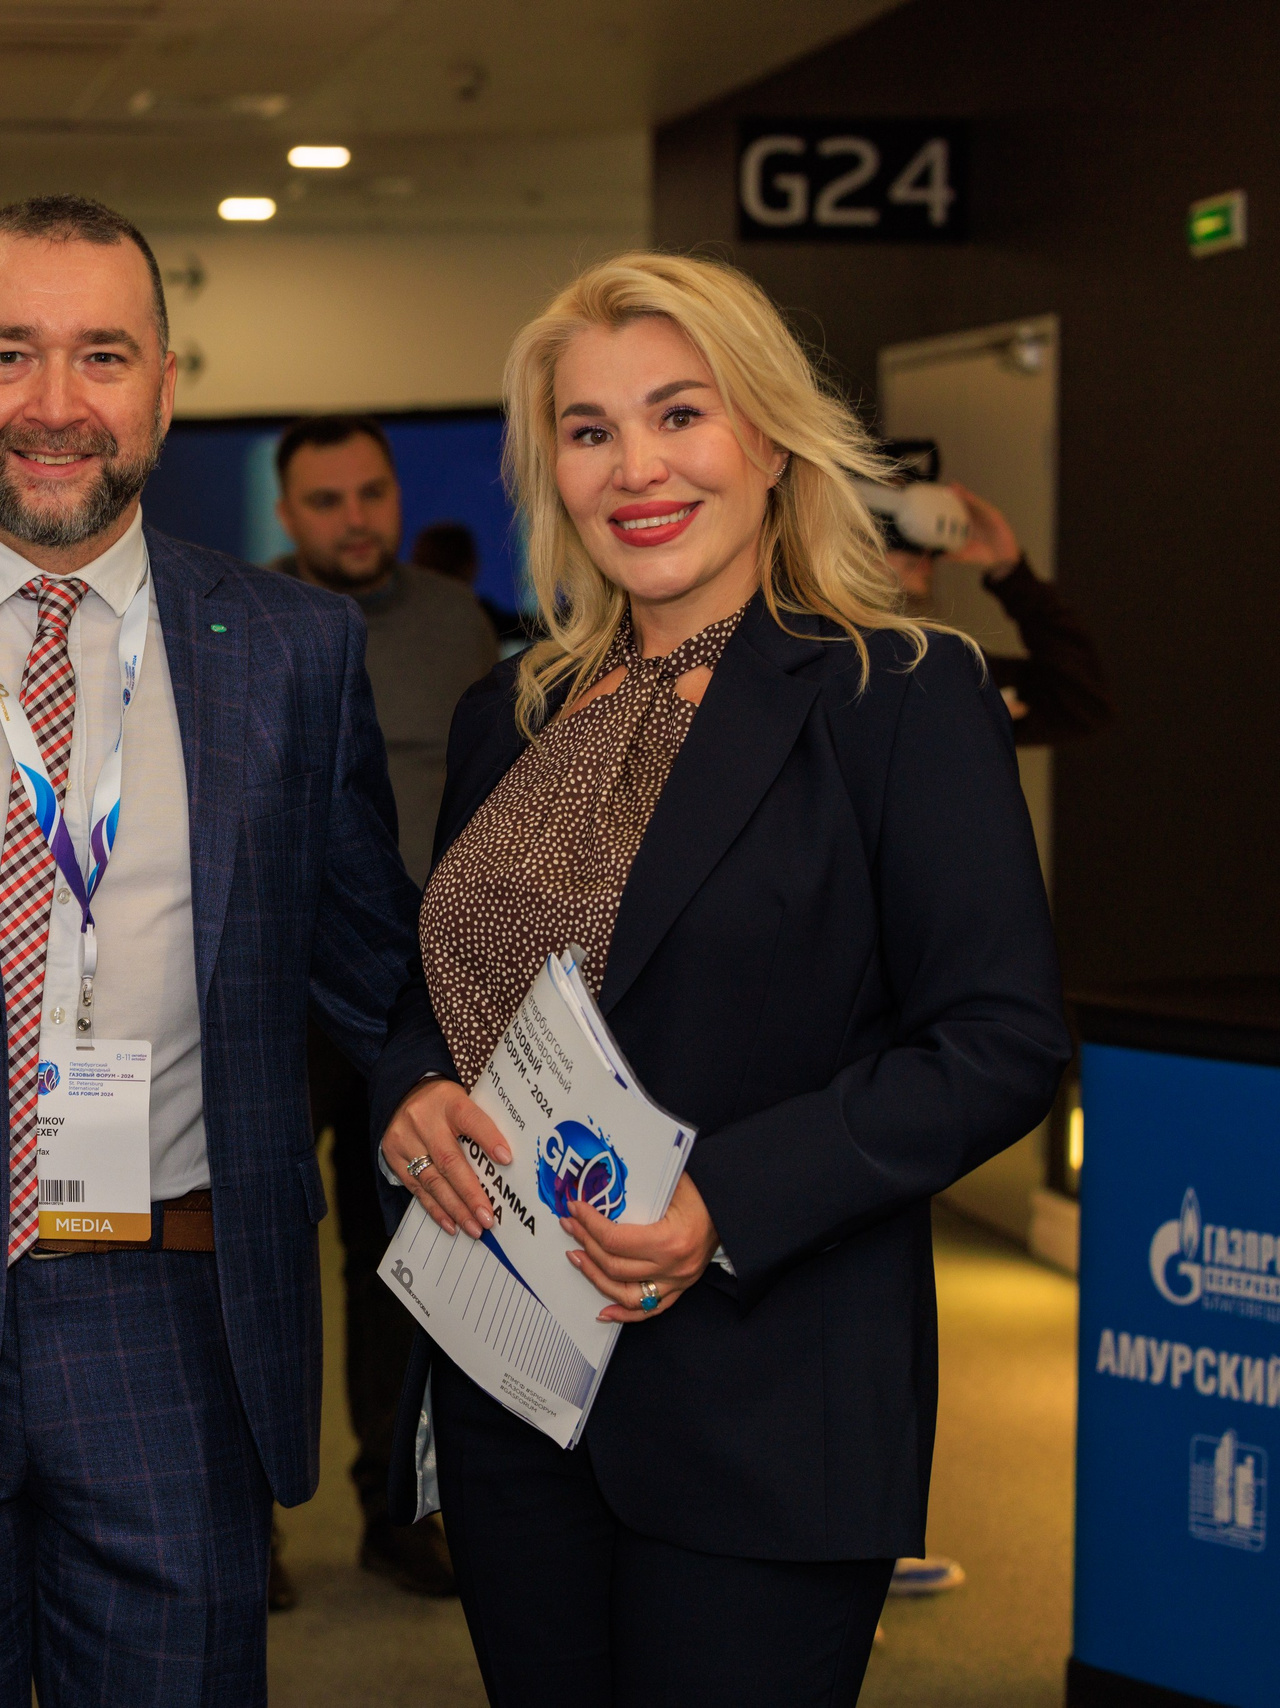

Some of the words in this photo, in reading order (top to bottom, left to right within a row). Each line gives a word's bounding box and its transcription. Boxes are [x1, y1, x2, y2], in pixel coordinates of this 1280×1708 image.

[741, 134, 956, 227] G24
[116, 1053, 131, 1061] 8-11
[504, 1031, 527, 1078] ФОРУМ
[530, 1084, 554, 1119] 2024
[37, 1117, 65, 1126] VIKOV
[458, 1134, 536, 1236] РОГРАММА
[56, 1218, 114, 1233] MEDIA
[1203, 1223, 1280, 1275] ГАЗПР
